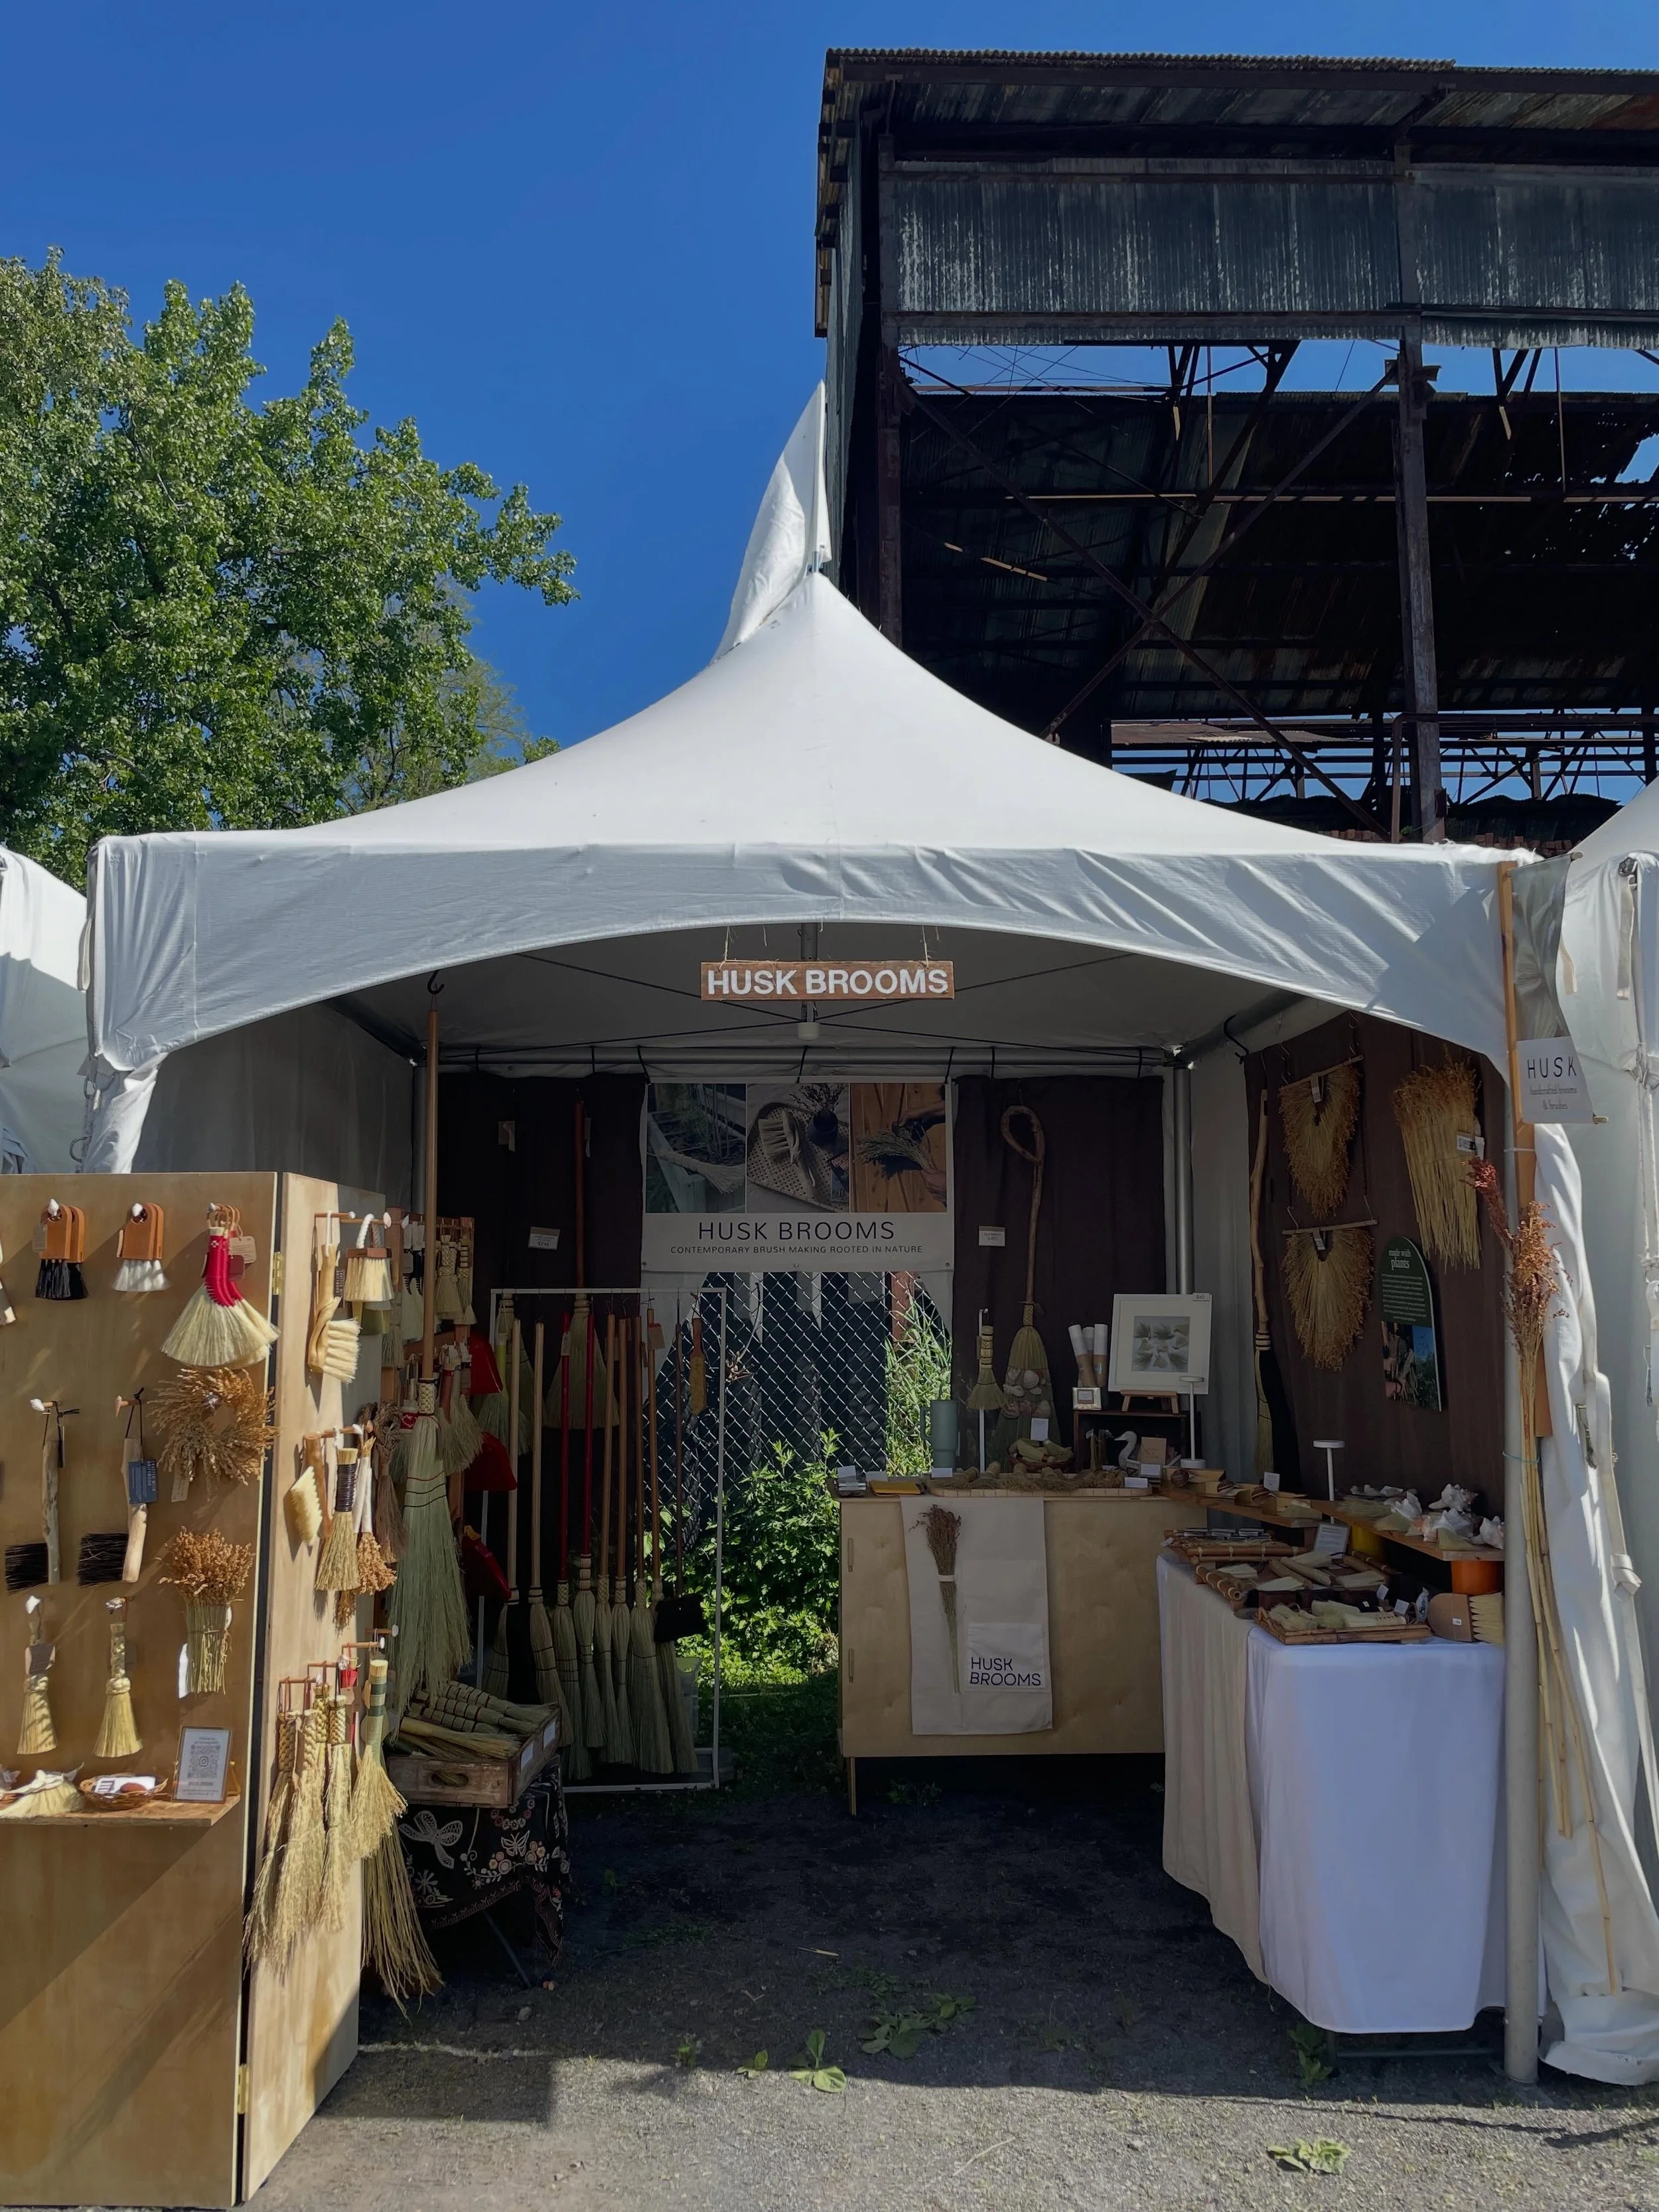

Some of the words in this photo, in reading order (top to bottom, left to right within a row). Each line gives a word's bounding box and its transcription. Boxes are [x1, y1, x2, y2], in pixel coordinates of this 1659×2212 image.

[707, 969, 798, 995] HUSK
[806, 968, 949, 994] BROOMS
[1527, 1056, 1577, 1079] HUSK
[698, 1222, 768, 1240] HUSK
[778, 1221, 895, 1240] BROOMS
[670, 1246, 750, 1254] CONTEMPORARY
[753, 1245, 786, 1254] BRUSH
[788, 1245, 827, 1254] MAKING
[830, 1245, 869, 1254] ROOTED
[885, 1245, 922, 1254] NATURE
[1391, 1258, 1409, 1271] plants
[971, 1657, 1013, 1671] HUSK
[970, 1671, 1041, 1686] BROOMS
